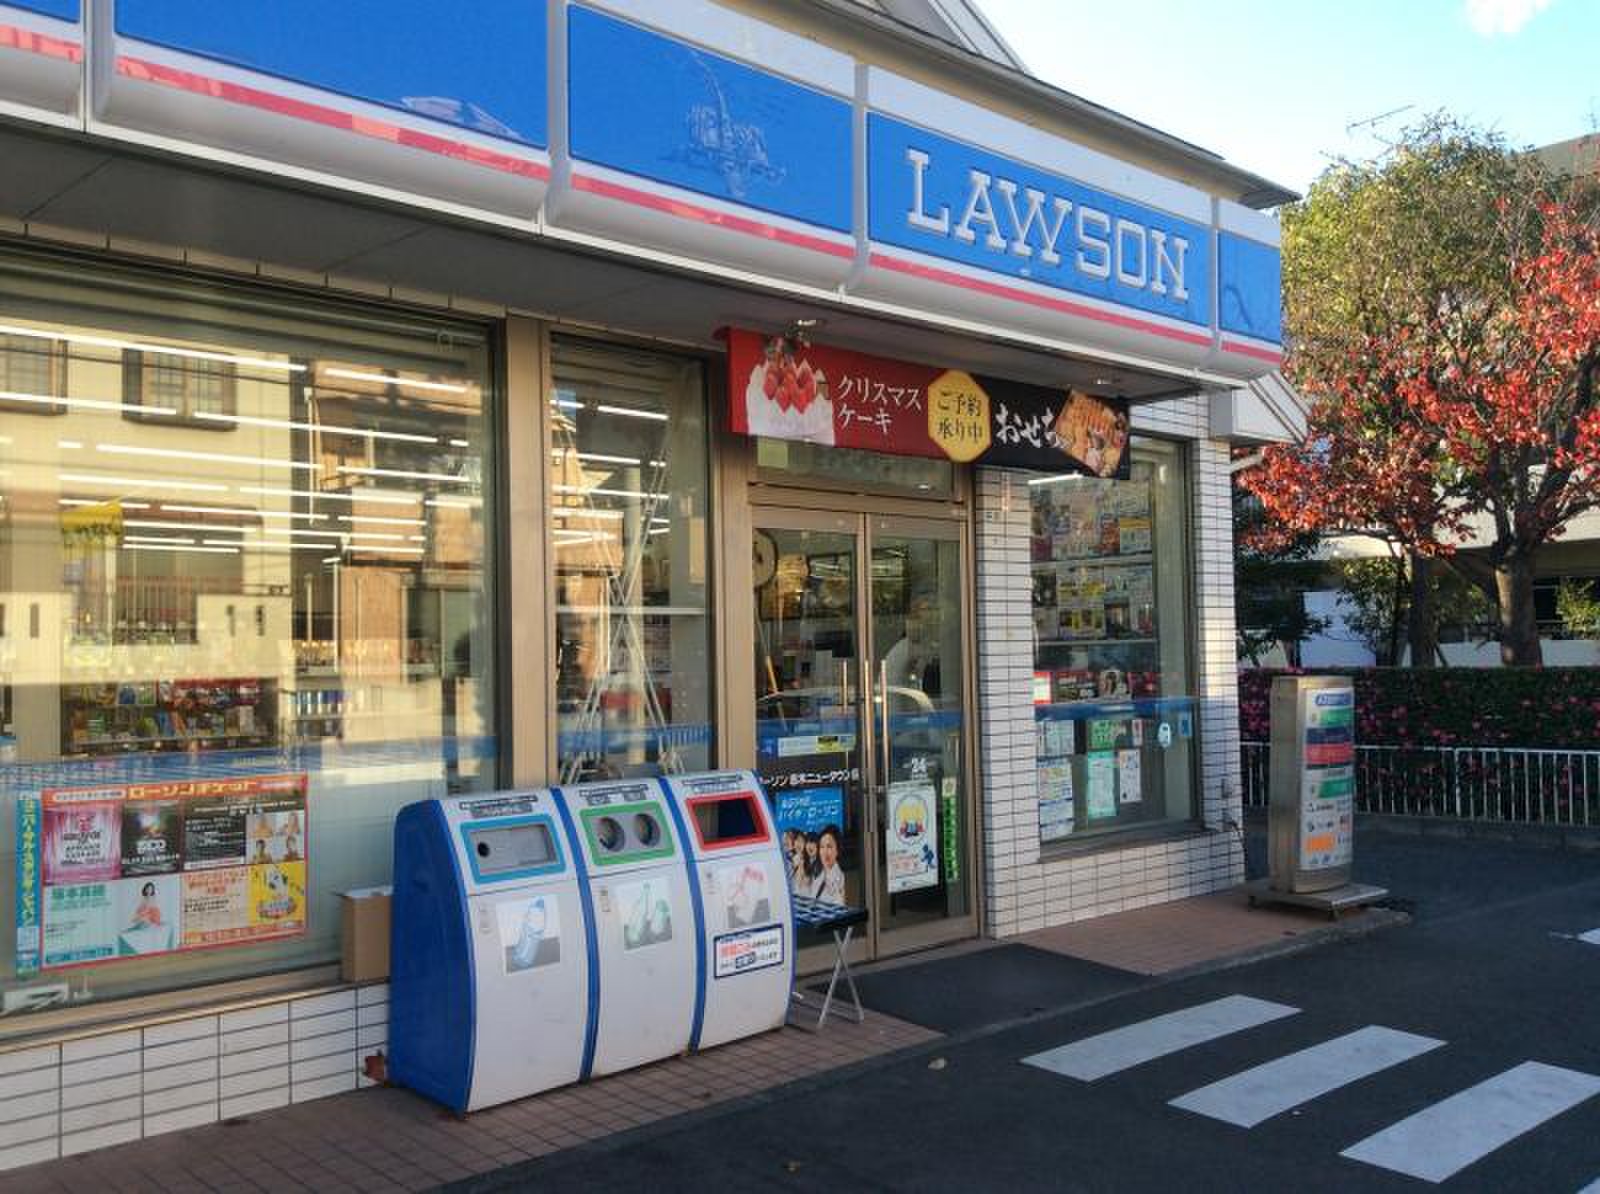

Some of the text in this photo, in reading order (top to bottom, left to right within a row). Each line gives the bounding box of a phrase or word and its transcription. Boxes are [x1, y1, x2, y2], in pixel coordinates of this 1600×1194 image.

[906, 148, 1189, 300] LAWSON
[838, 375, 921, 411] クリスマス
[938, 387, 982, 417] ご予約
[838, 403, 892, 435] ケーキ
[937, 416, 983, 444] 承り中
